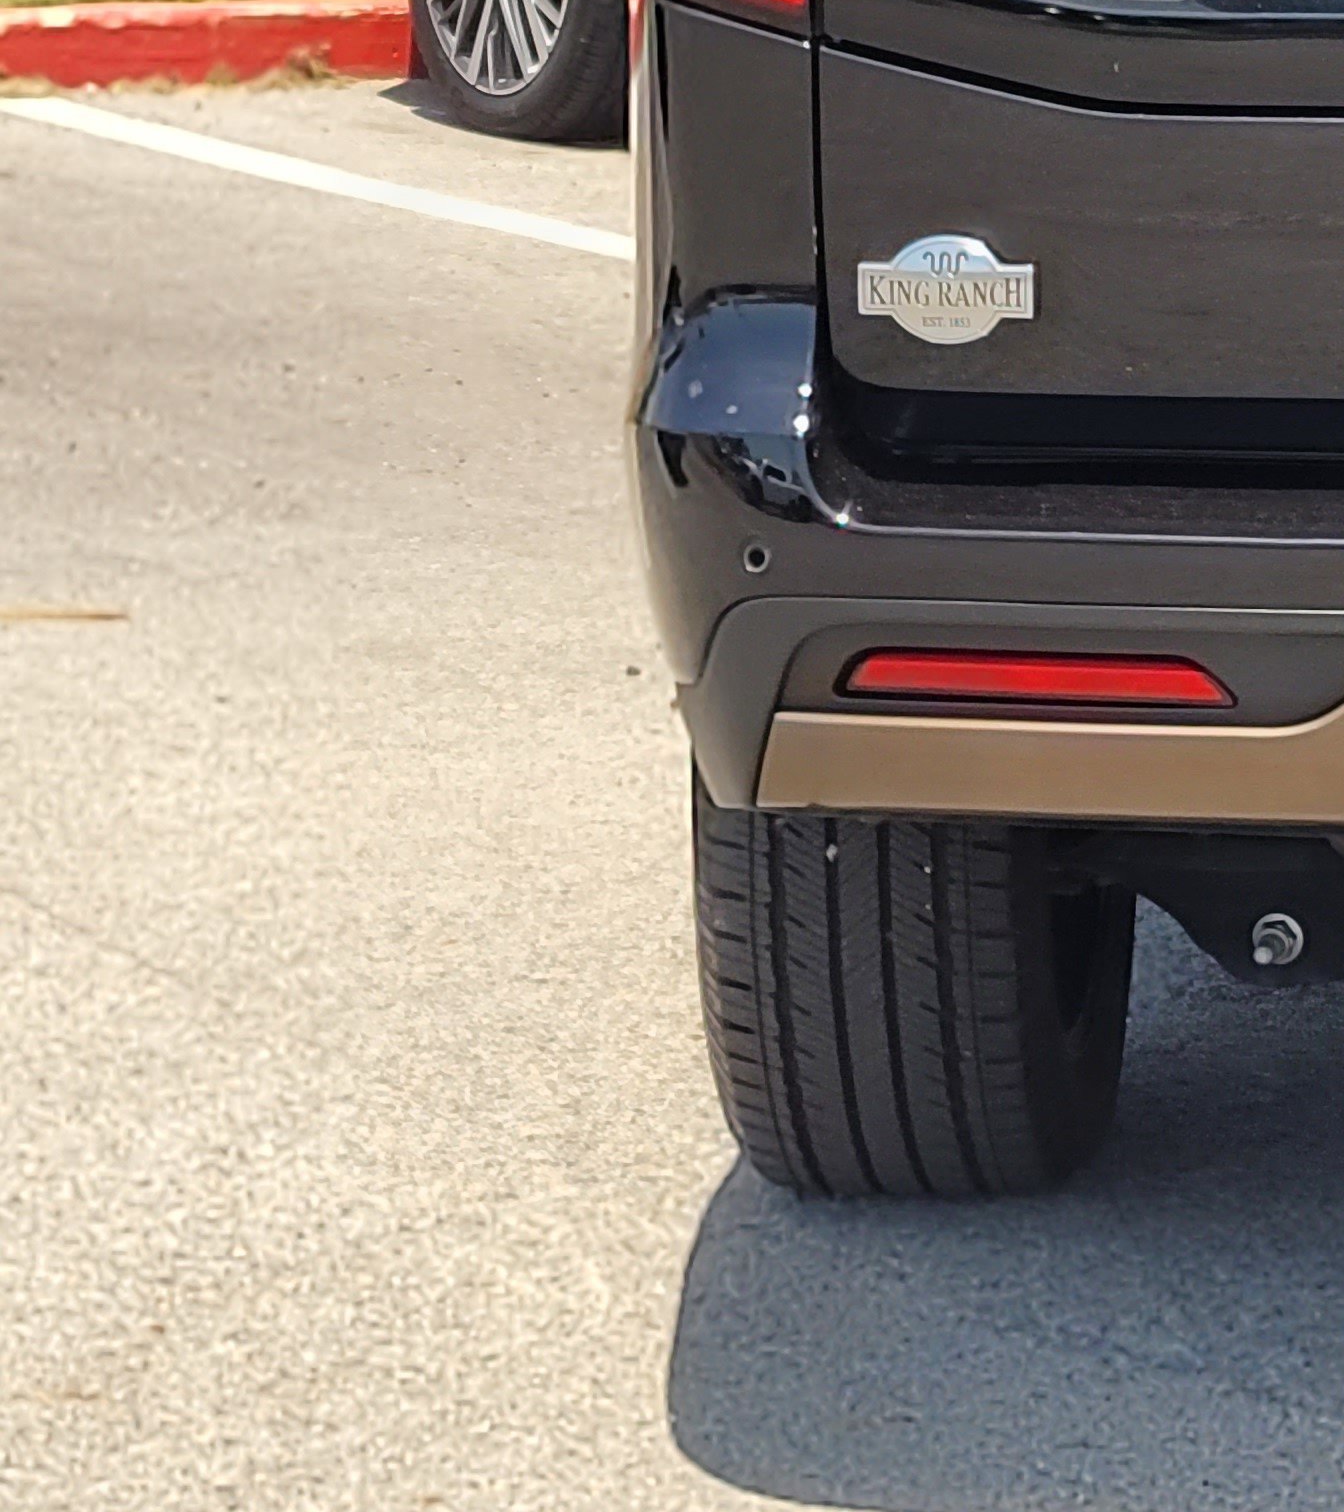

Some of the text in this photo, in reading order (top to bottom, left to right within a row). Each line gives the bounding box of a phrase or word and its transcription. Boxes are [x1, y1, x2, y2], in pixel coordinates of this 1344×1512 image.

[869, 274, 1022, 308] KING RANCH
[922, 316, 971, 328] EST. 1853
